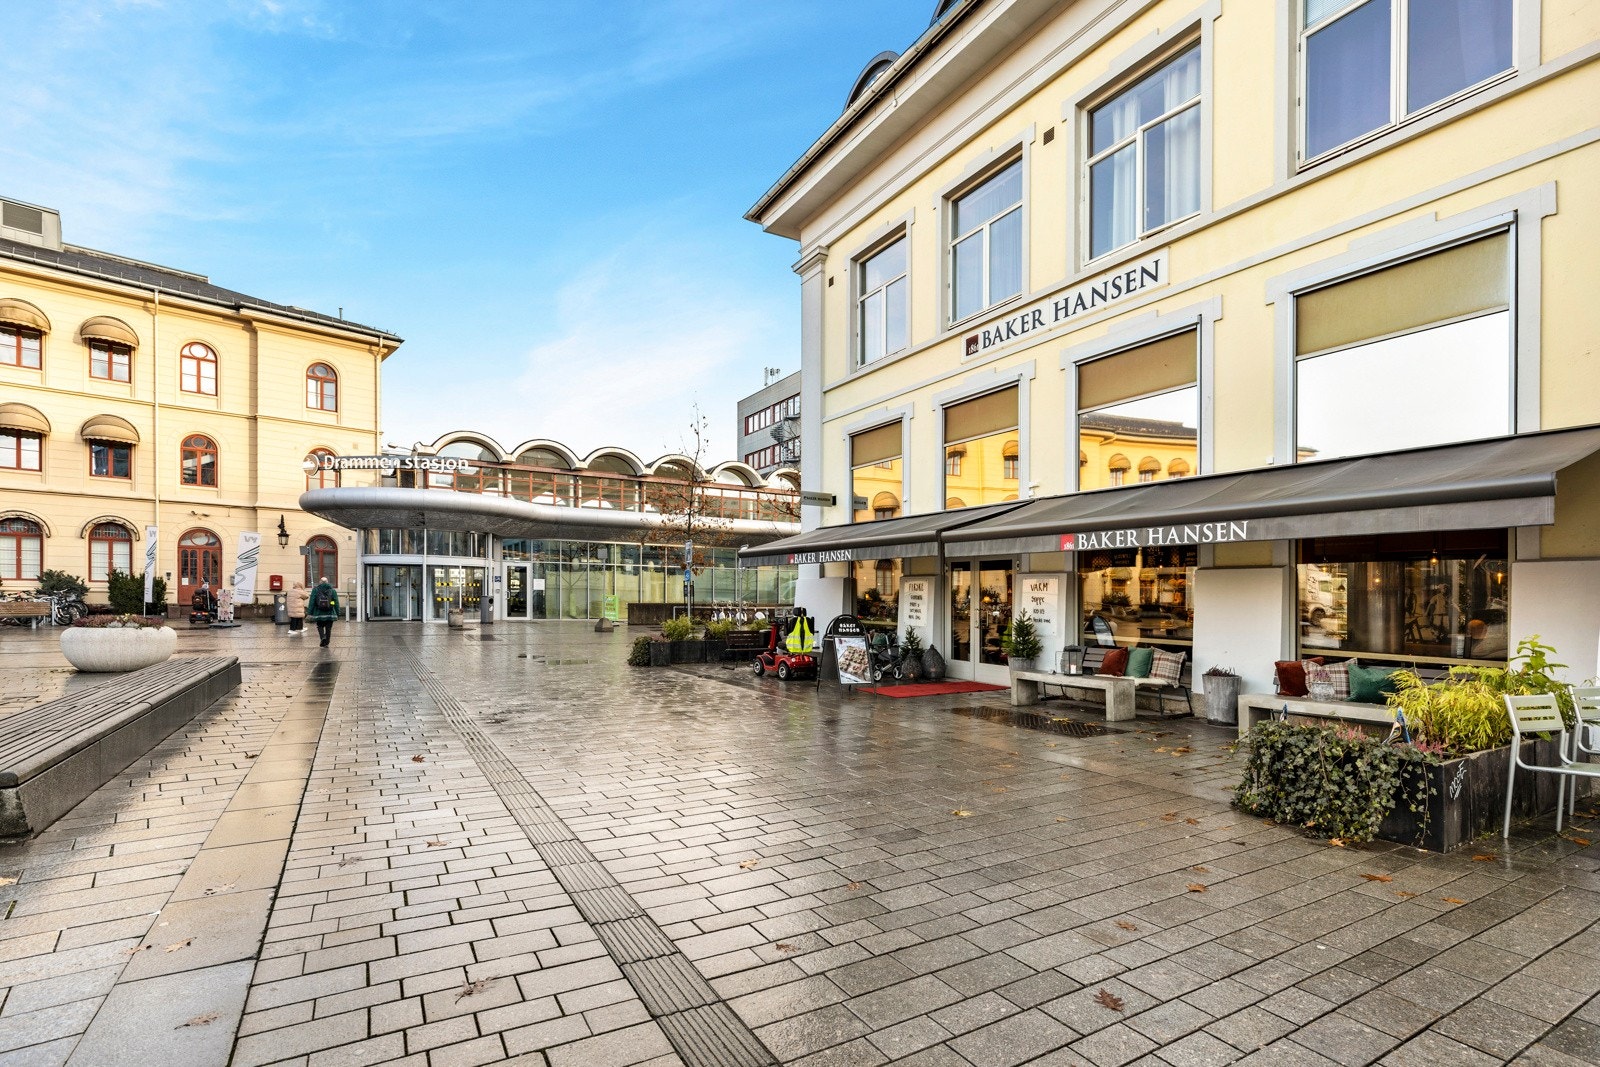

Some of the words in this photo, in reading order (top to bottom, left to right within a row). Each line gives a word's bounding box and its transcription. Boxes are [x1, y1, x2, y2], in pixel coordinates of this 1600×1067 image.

[981, 308, 1045, 350] BAKER
[1053, 259, 1160, 322] HANSEN
[323, 455, 399, 470] Drammen
[405, 457, 469, 473] stasjon
[1077, 529, 1140, 550] BAKER
[1147, 521, 1249, 546] HANSEN
[794, 552, 816, 564] BAKER
[819, 549, 852, 562] HANSEN
